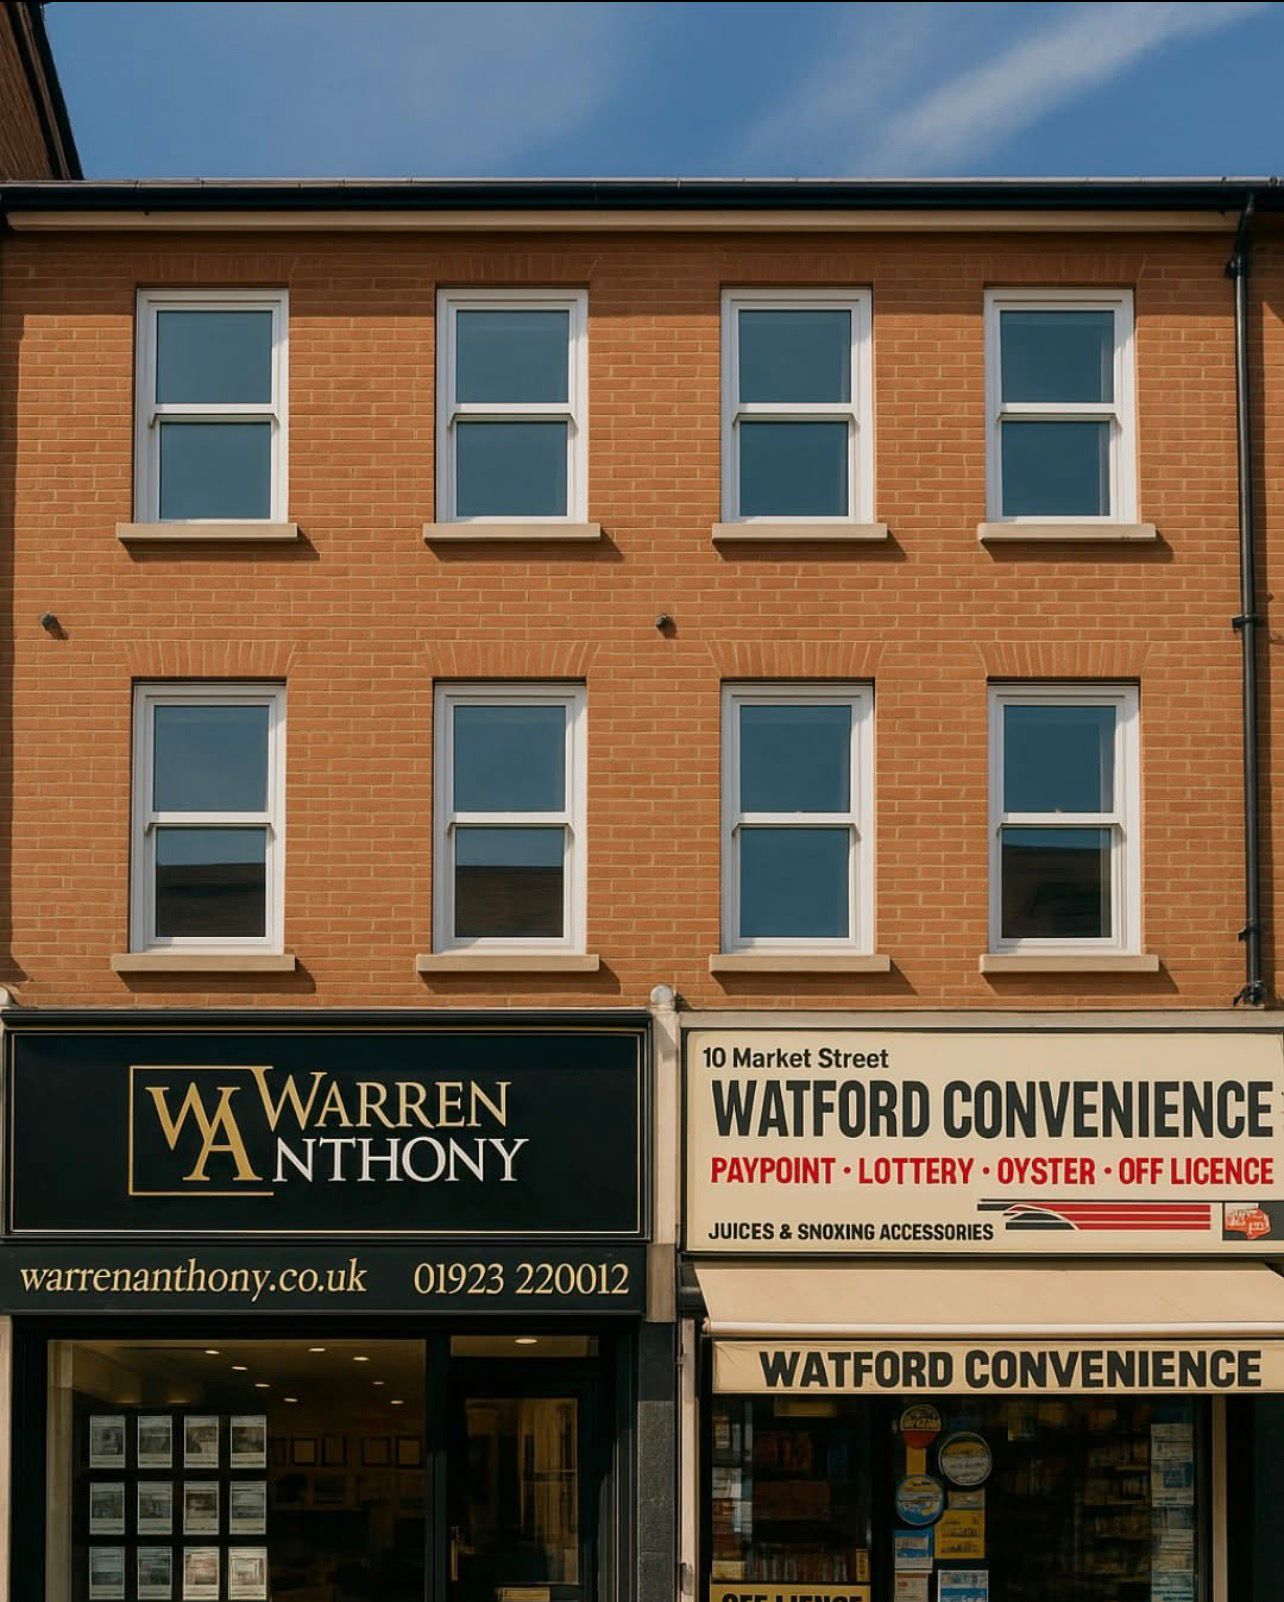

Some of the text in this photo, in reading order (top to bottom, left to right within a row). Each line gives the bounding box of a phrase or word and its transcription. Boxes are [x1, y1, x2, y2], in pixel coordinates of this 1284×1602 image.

[704, 1047, 889, 1069] 10 Market Street
[250, 1066, 512, 1132] WARREN
[711, 1079, 1274, 1139] WATFORD CONVENIENCE
[711, 1157, 1274, 1185] PAYPOINT LOTTERY OYSTER OFF LICENCE
[708, 1222, 994, 1241] JUICES & SNOXING ACCESSORIES
[19, 1258, 630, 1303] warrenanthony.co.uk 01923 220012
[759, 1350, 1262, 1389] WATFORD CONVENIENCE
